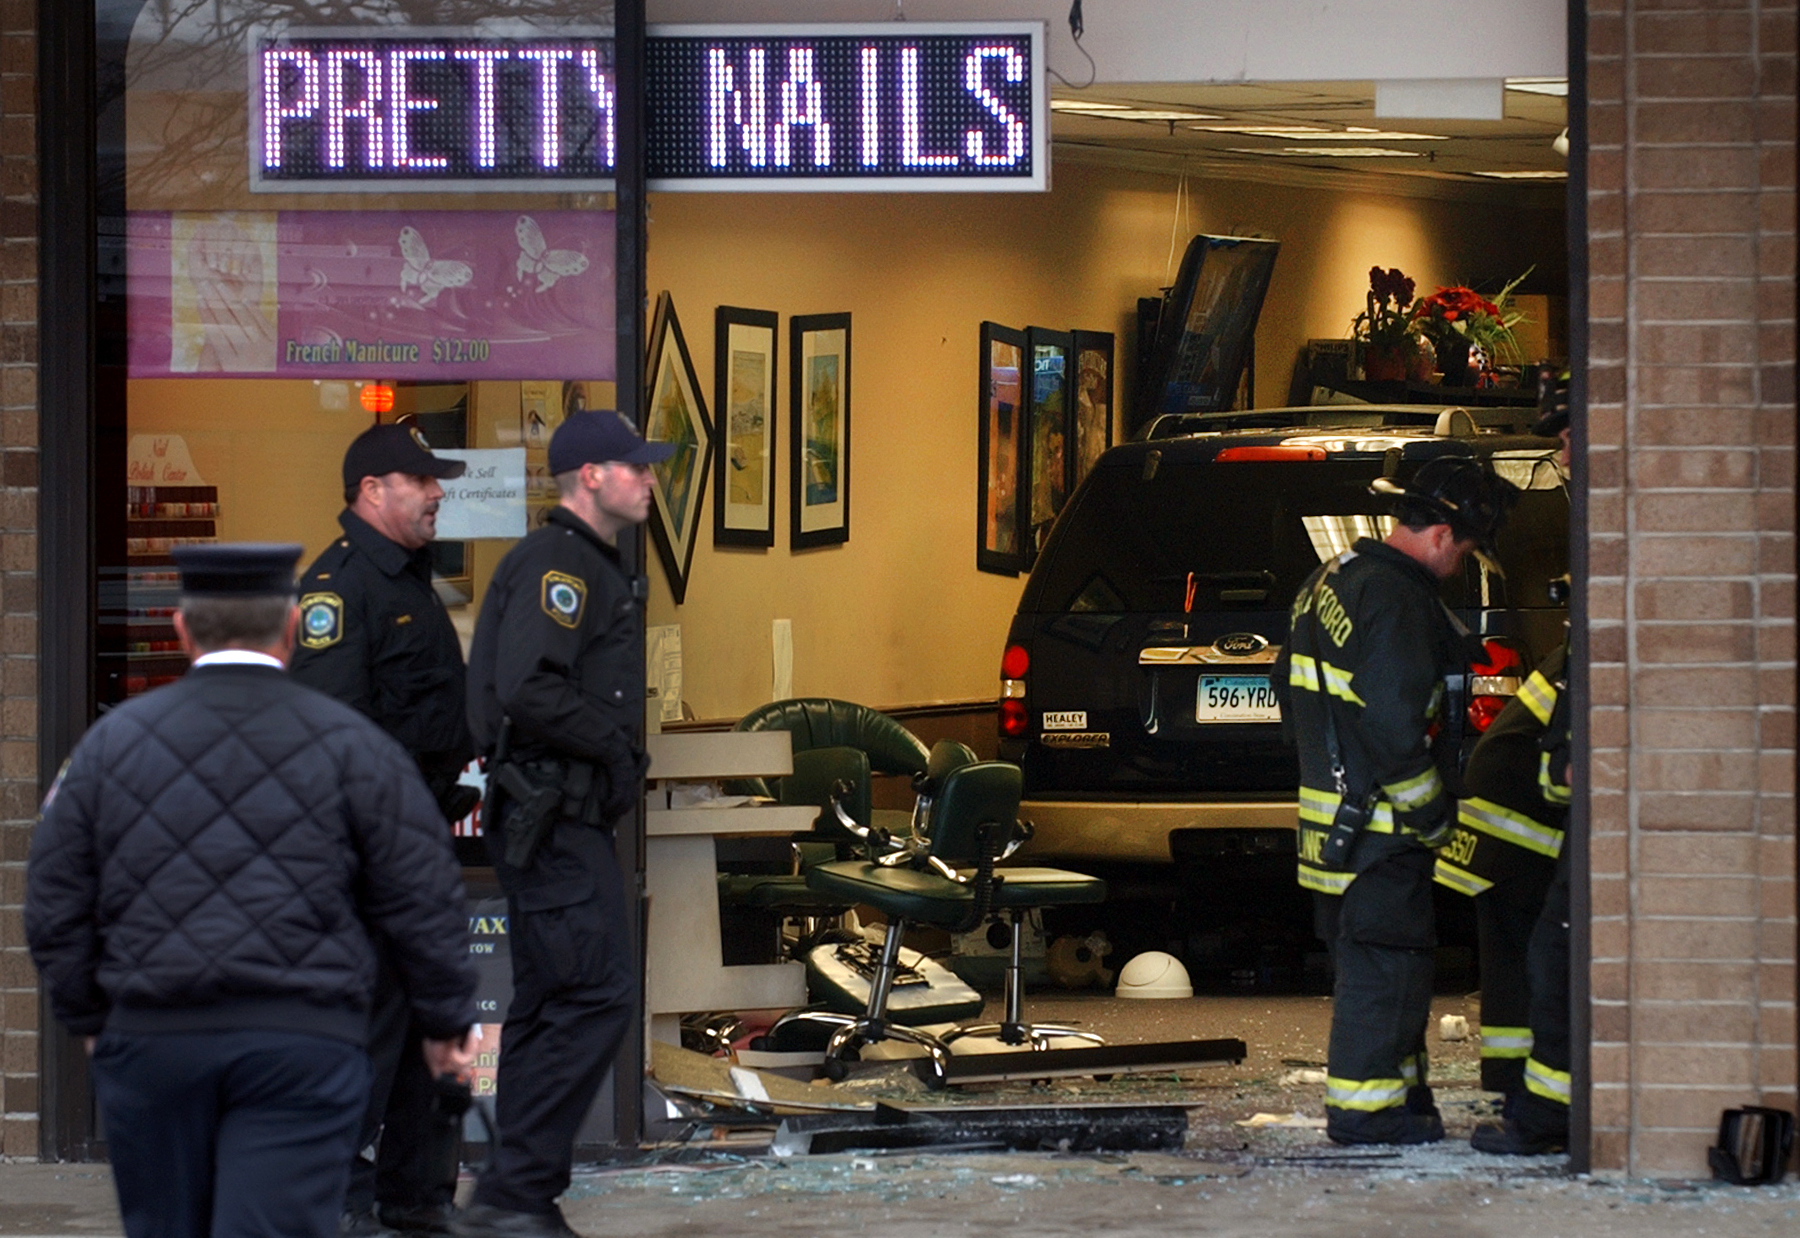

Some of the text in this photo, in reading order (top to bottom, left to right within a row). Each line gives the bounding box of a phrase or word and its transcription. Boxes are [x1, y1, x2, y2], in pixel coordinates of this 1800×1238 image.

[263, 46, 1025, 169] PRETTY NAILS
[285, 337, 491, 364] French Manicure $12.00
[475, 466, 498, 479] Sell
[458, 487, 518, 502] Certificates
[1223, 637, 1256, 650] Ford
[1045, 713, 1084, 723] HEALEY
[1042, 734, 1108, 743] EXPLORER
[467, 916, 508, 935] AX
[469, 942, 496, 954] row
